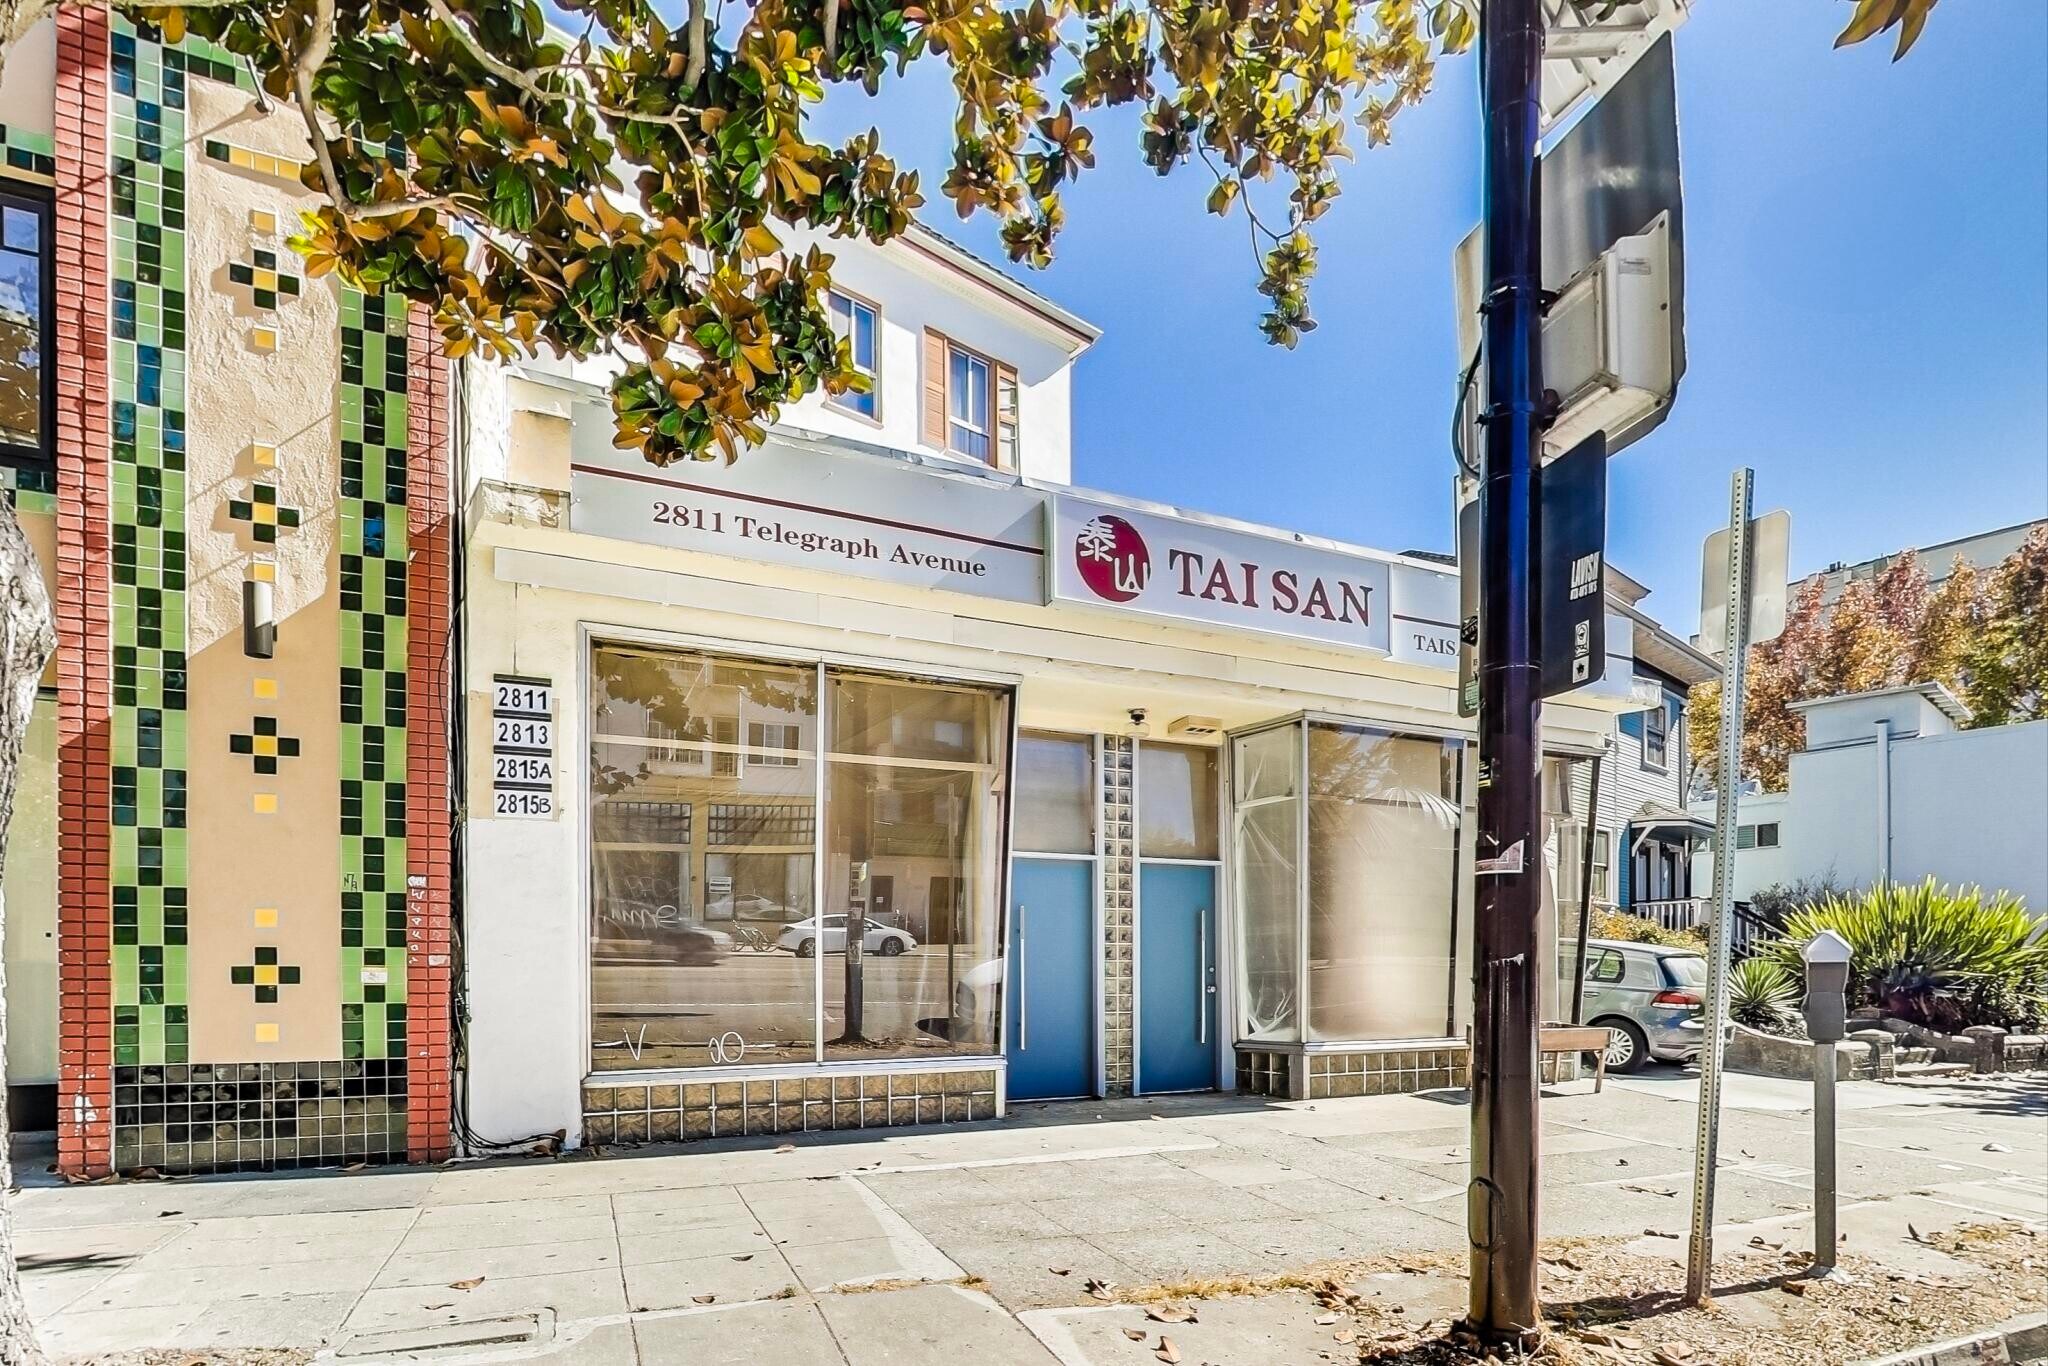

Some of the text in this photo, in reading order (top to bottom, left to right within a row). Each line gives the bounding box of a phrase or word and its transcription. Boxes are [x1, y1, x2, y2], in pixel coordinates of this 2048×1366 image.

[652, 501, 986, 577] 2811 Telegraph Avenue
[1078, 517, 1148, 595] 泰山
[1169, 548, 1374, 627] TAI SAN
[1413, 634, 1456, 656] TAIS
[498, 687, 547, 709] 2811
[498, 722, 548, 745] 2813
[496, 758, 552, 780] 2815A
[496, 794, 551, 815] 2815B
